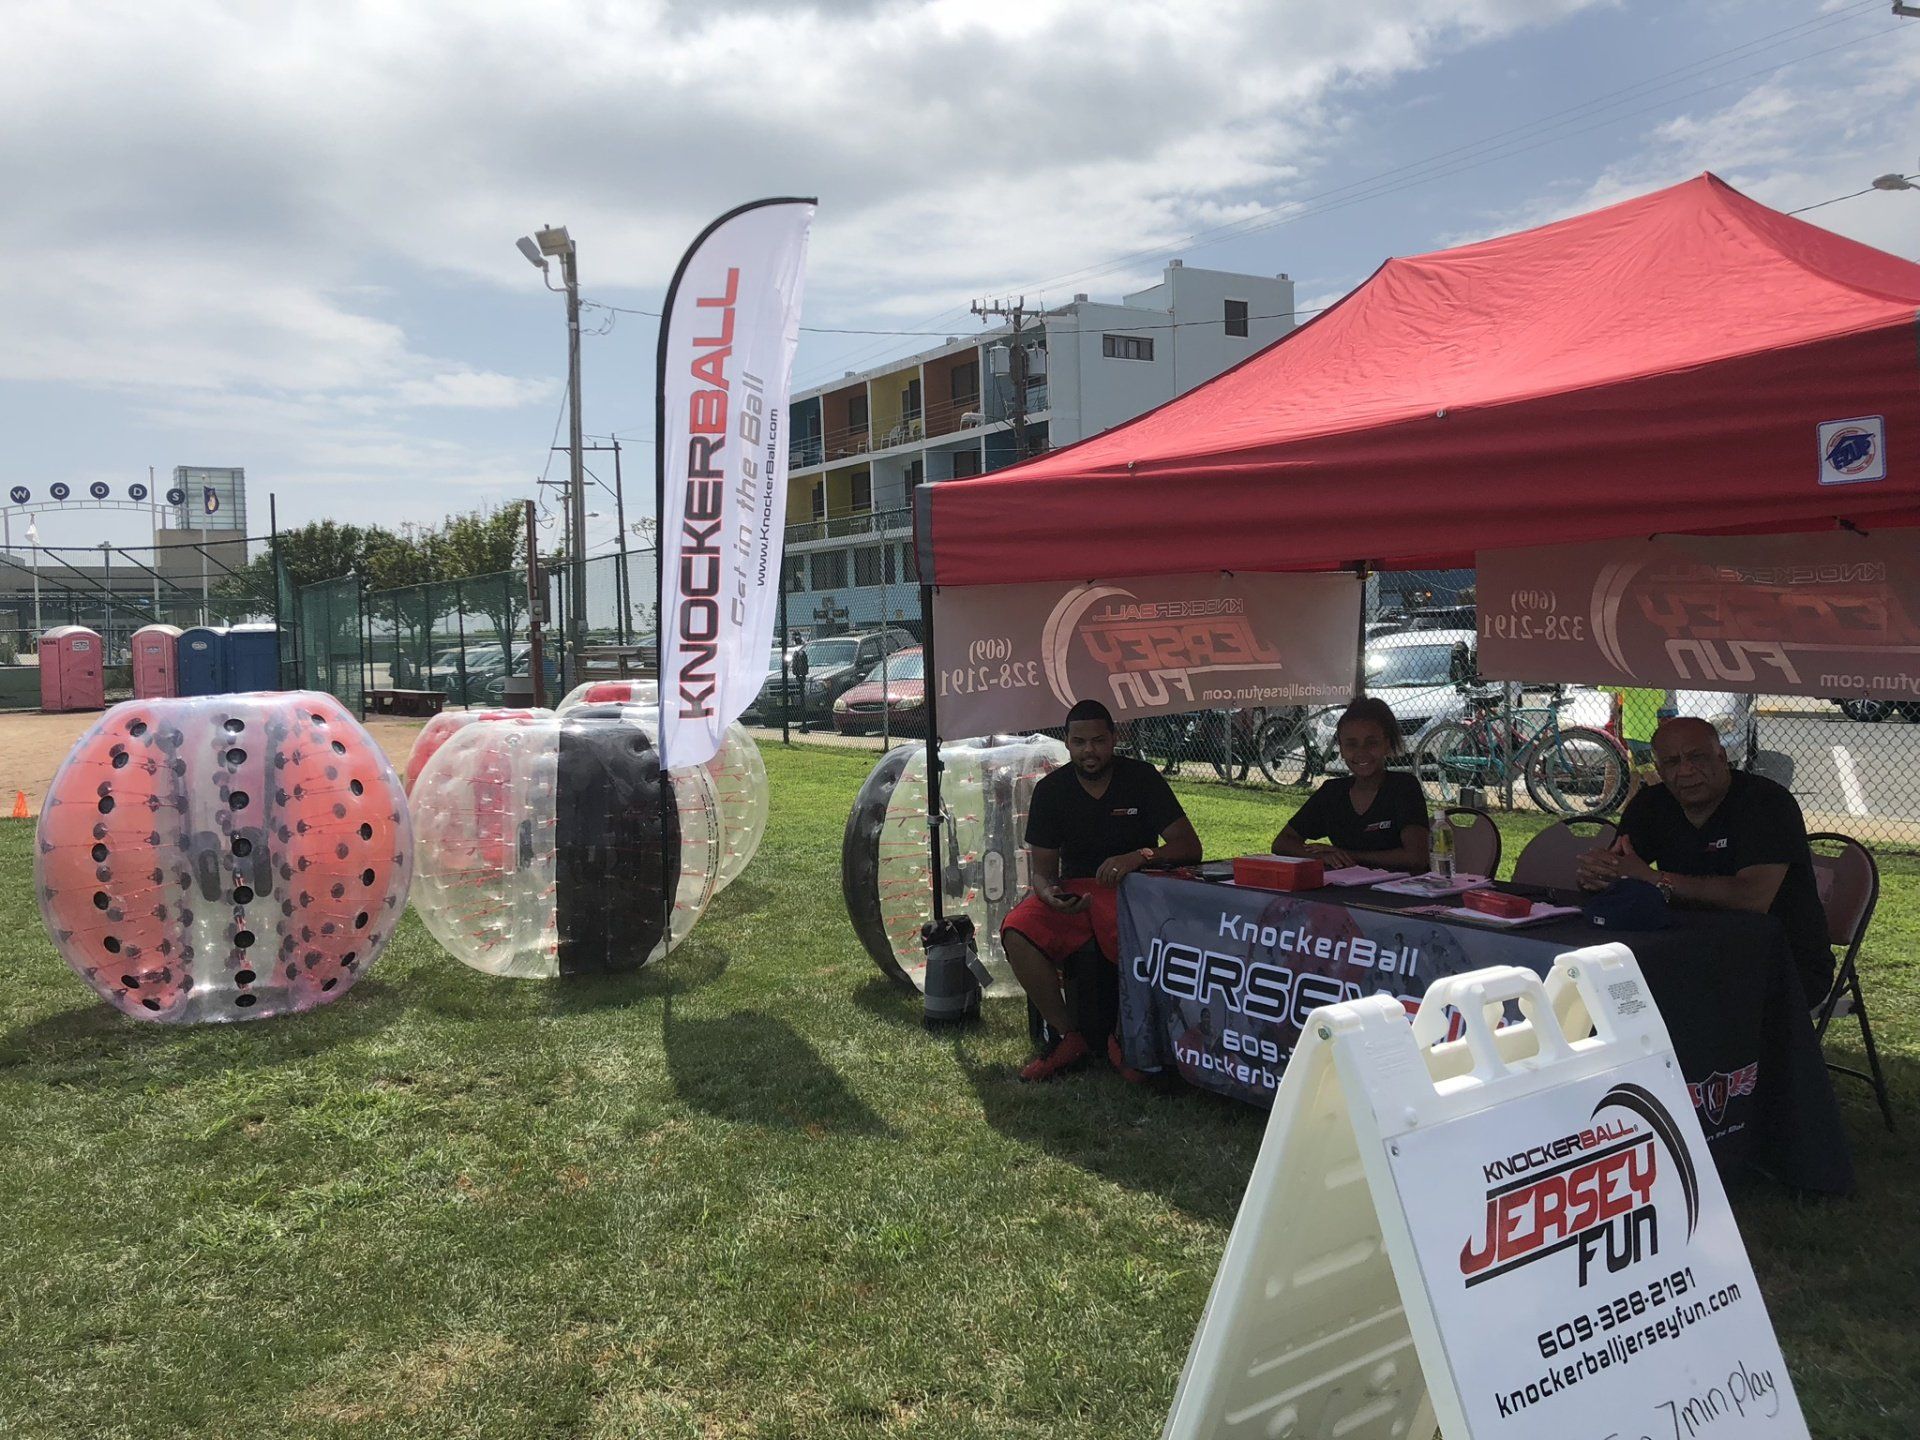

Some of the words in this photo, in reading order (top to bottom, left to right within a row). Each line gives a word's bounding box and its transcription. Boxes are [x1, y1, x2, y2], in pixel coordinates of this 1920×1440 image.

[739, 371, 764, 446] Ball
[679, 267, 740, 719] KNOCKERBALL
[735, 457, 759, 513] the
[757, 408, 778, 586] www.KnockerBall.com
[733, 524, 753, 557] in
[1219, 911, 1419, 977] KnockerBall
[1460, 1141, 1657, 1275] JERSEY
[1579, 1204, 1659, 1288] FUN
[1495, 1283, 1742, 1418] knockerballjerseyfun.com
[1537, 1267, 1697, 1359] 609-328-2191
[1728, 1360, 1780, 1418] play
